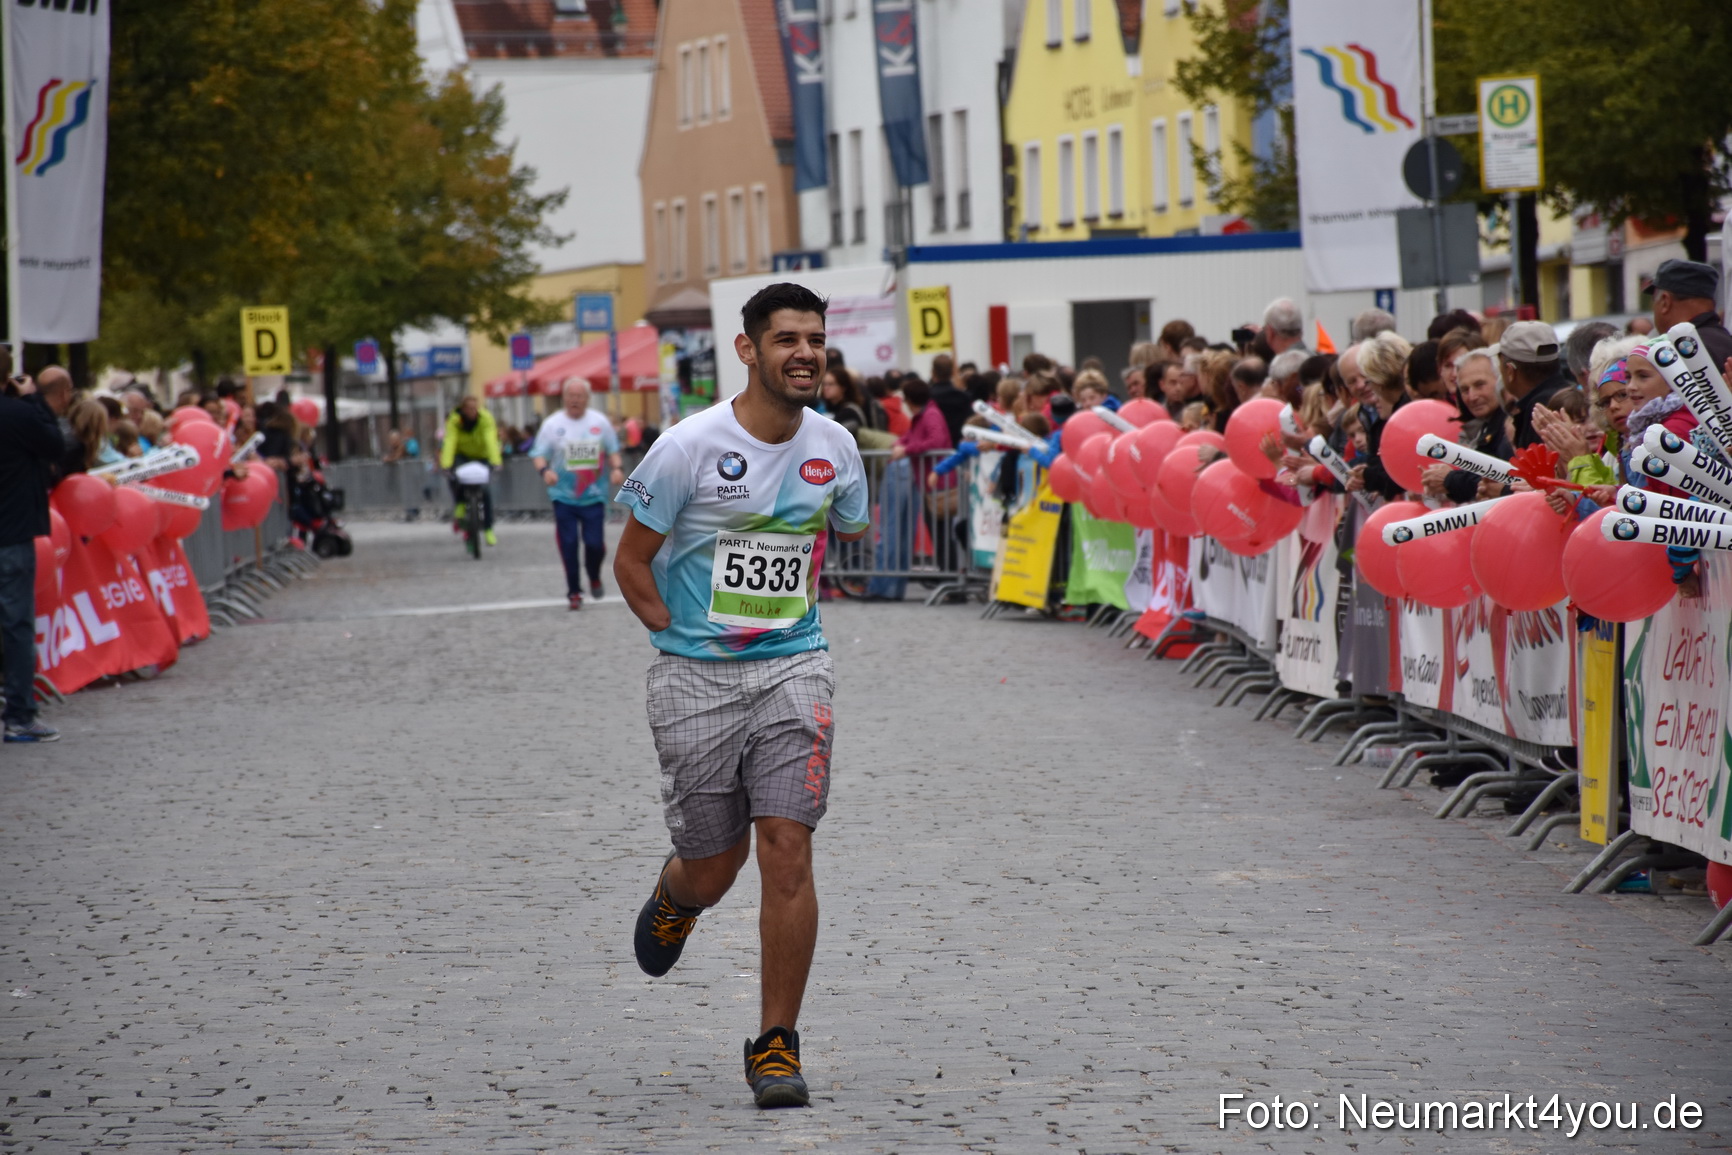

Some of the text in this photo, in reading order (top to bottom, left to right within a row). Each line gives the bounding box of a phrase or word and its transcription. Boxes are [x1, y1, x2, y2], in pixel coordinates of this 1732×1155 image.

[921, 307, 943, 338] D
[255, 328, 277, 360] D
[1673, 371, 1711, 416] BMW
[804, 465, 832, 479] Hervis
[717, 484, 750, 494] PARTL
[1659, 499, 1717, 525] BMW
[1423, 513, 1468, 537] BMW
[1651, 524, 1711, 548] BMW
[719, 538, 800, 553] PARTL Neumarkt
[724, 552, 802, 592] 5333
